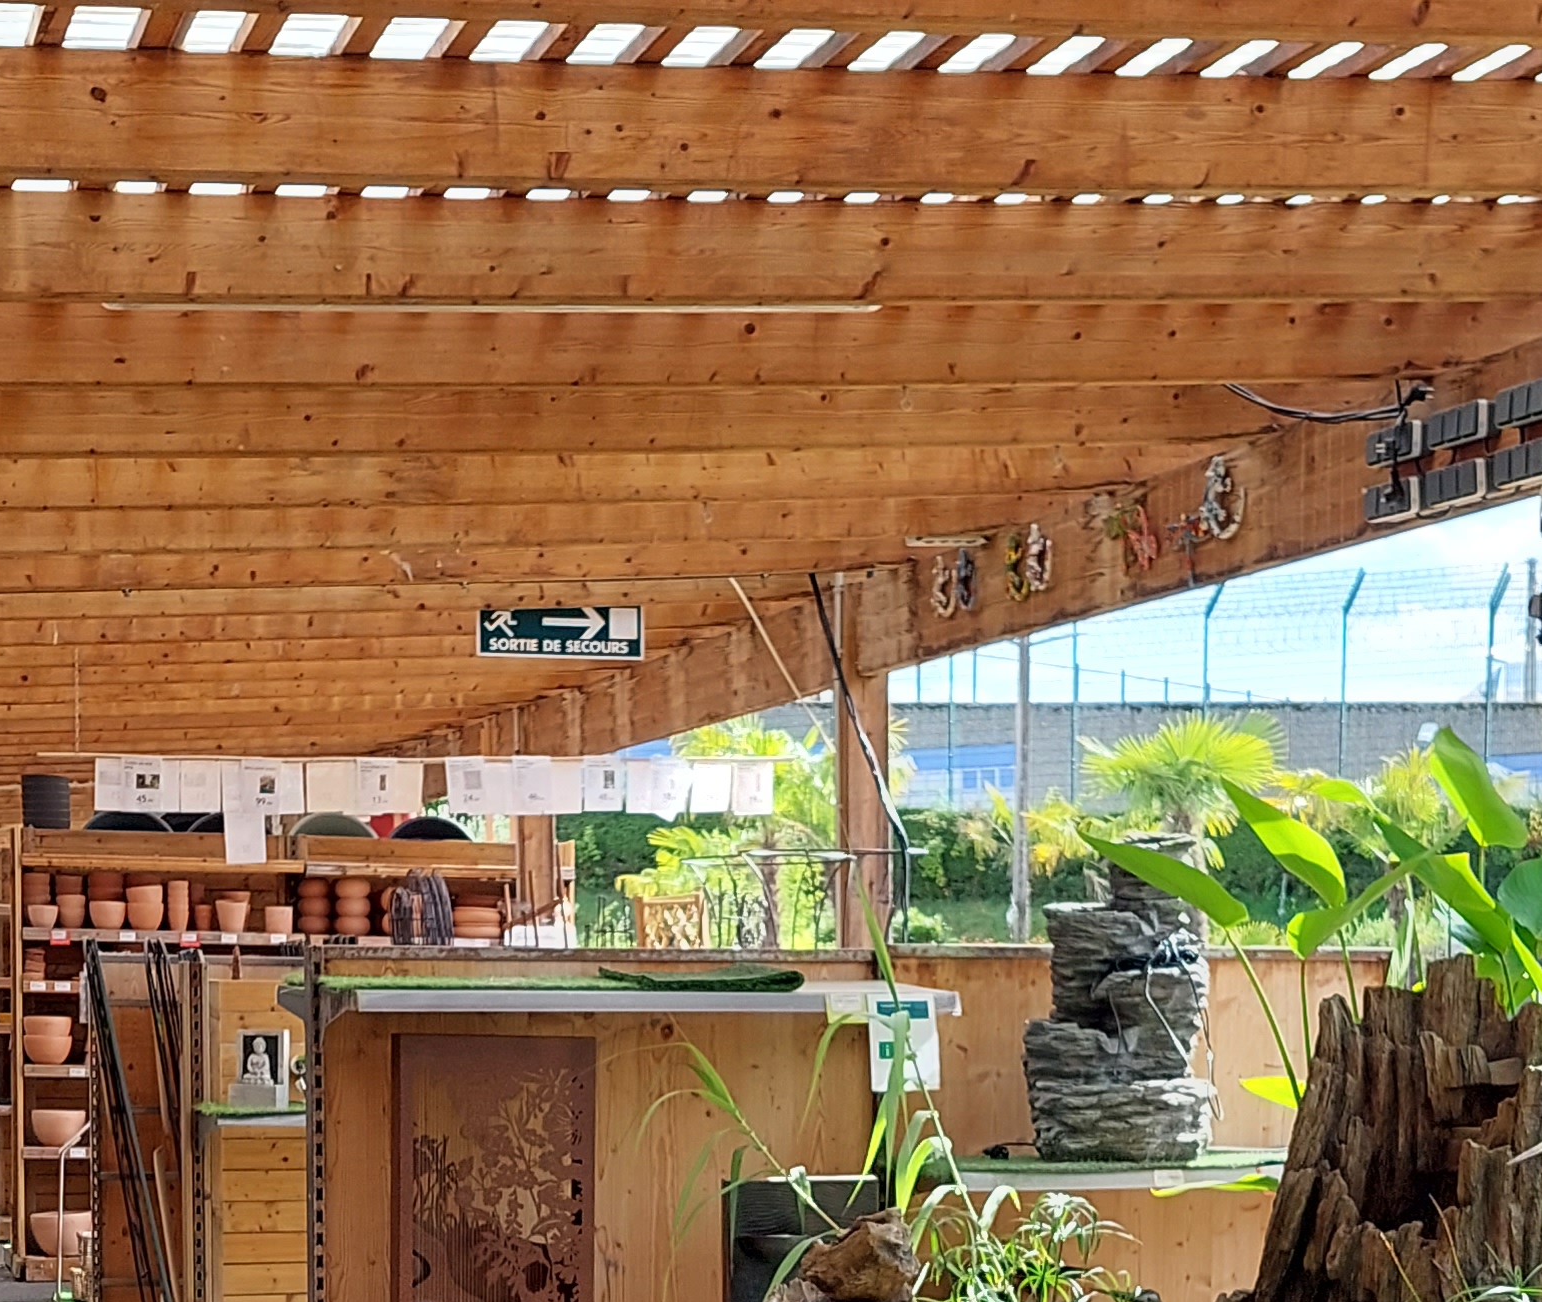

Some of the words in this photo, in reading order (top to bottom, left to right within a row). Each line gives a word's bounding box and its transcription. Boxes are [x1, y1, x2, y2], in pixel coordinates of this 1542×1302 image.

[489, 638, 538, 652] SORTIE
[542, 639, 561, 653] DE
[565, 640, 629, 654] SECOURS
